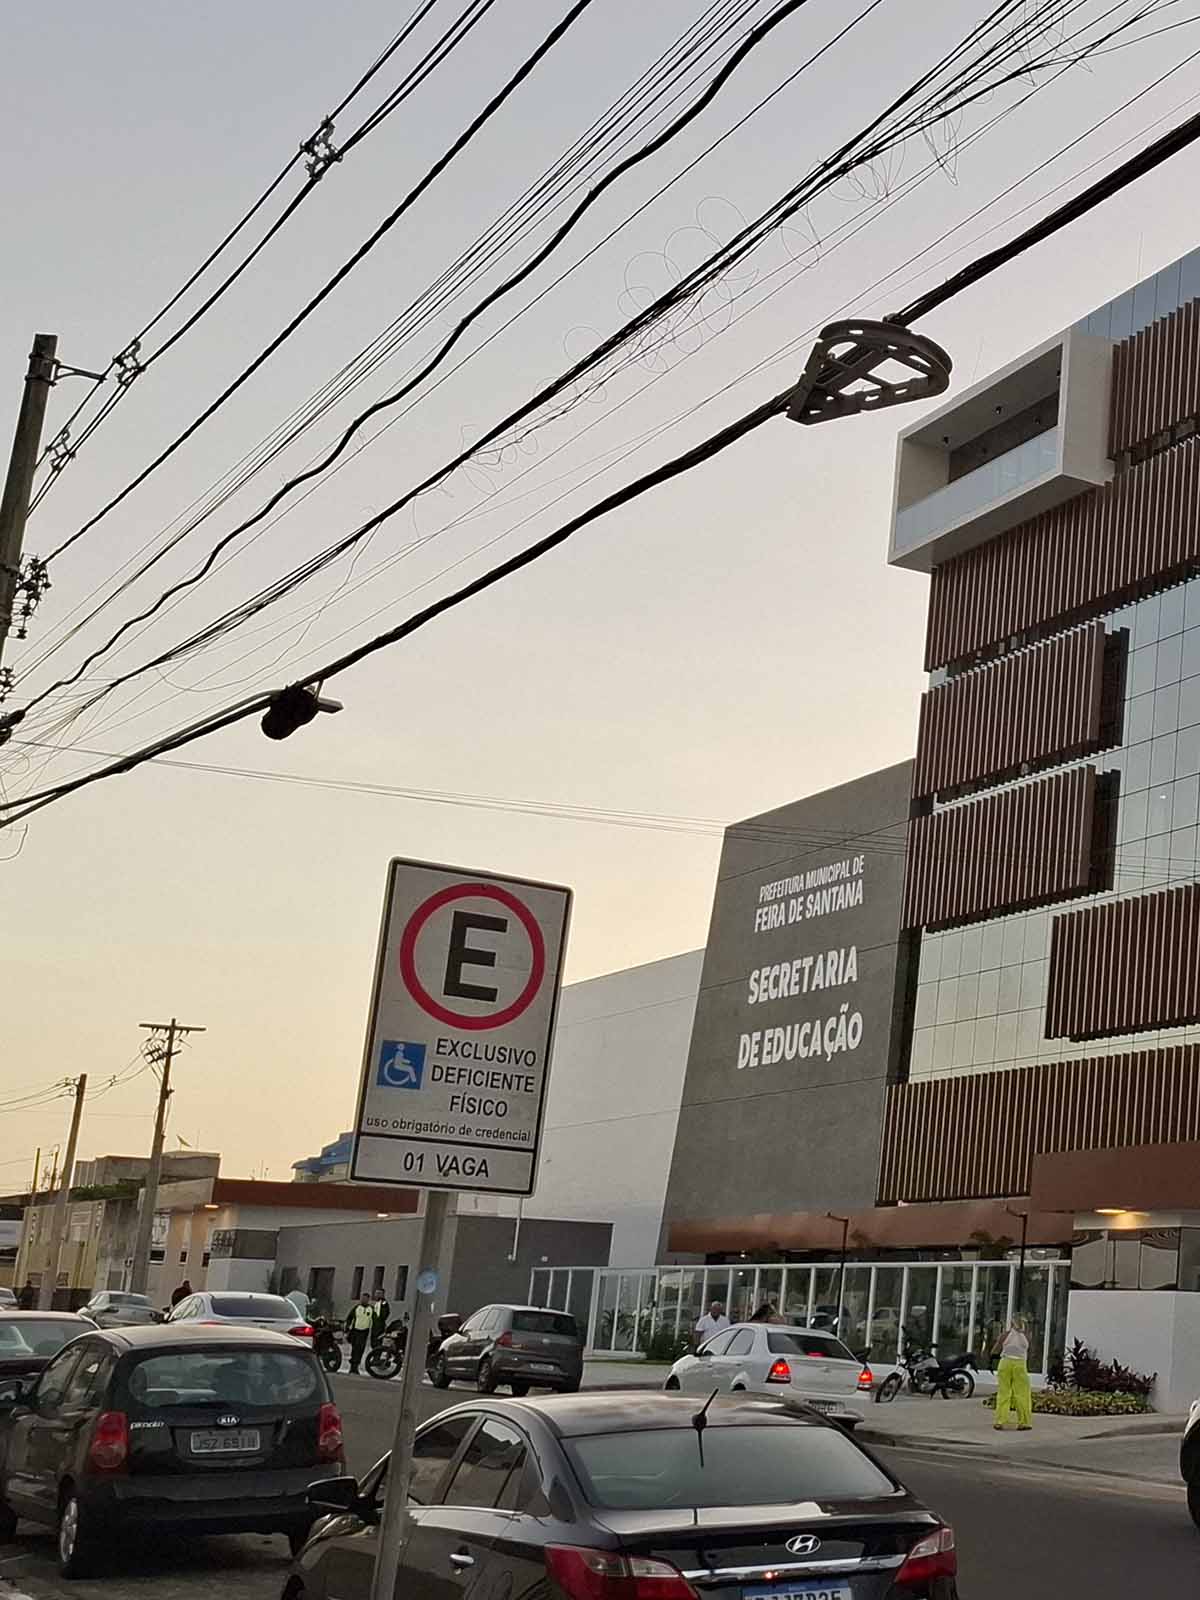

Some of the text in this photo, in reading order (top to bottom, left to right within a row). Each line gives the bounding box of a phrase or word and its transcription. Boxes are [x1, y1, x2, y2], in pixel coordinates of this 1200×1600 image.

[759, 855, 864, 904] PREFEITURA MUNICIPAL DE
[754, 879, 863, 933] FEIRA DE SANTANA
[442, 910, 508, 1003] E
[747, 946, 858, 1005] SECRETARIA
[737, 1003, 863, 1069] DE EDUCAÇÃO
[436, 1038, 537, 1067] EXCLUSIVO
[431, 1064, 535, 1093] DEFICIENTE
[449, 1092, 508, 1118] FÍSICO
[366, 1117, 531, 1142] uso obrigatório de credencial
[403, 1152, 489, 1178] 01 VAGA
[221, 1416, 237, 1424] KIA
